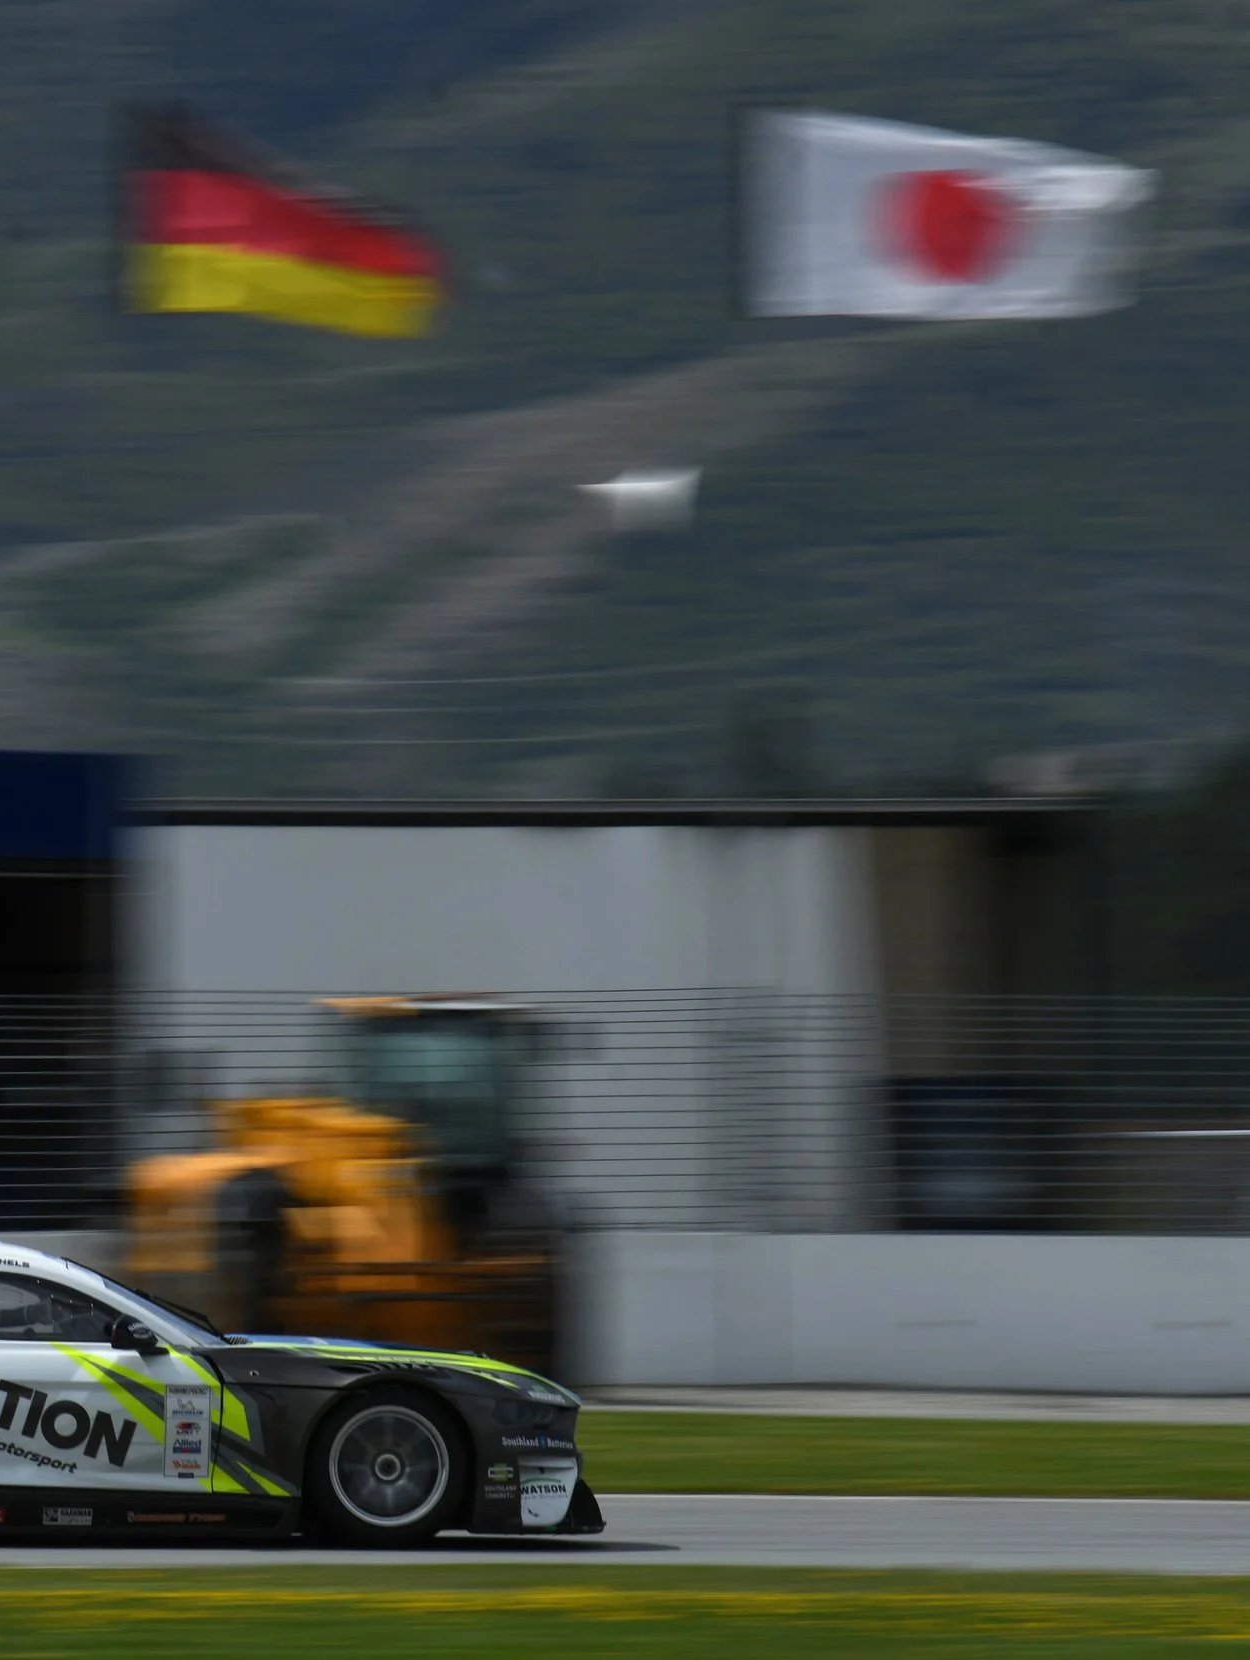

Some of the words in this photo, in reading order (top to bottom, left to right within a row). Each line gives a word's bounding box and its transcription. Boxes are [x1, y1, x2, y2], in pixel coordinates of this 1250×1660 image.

[173, 1438, 202, 1448] Allied
[501, 1435, 540, 1447] Southland
[520, 1483, 567, 1494] WATSON
